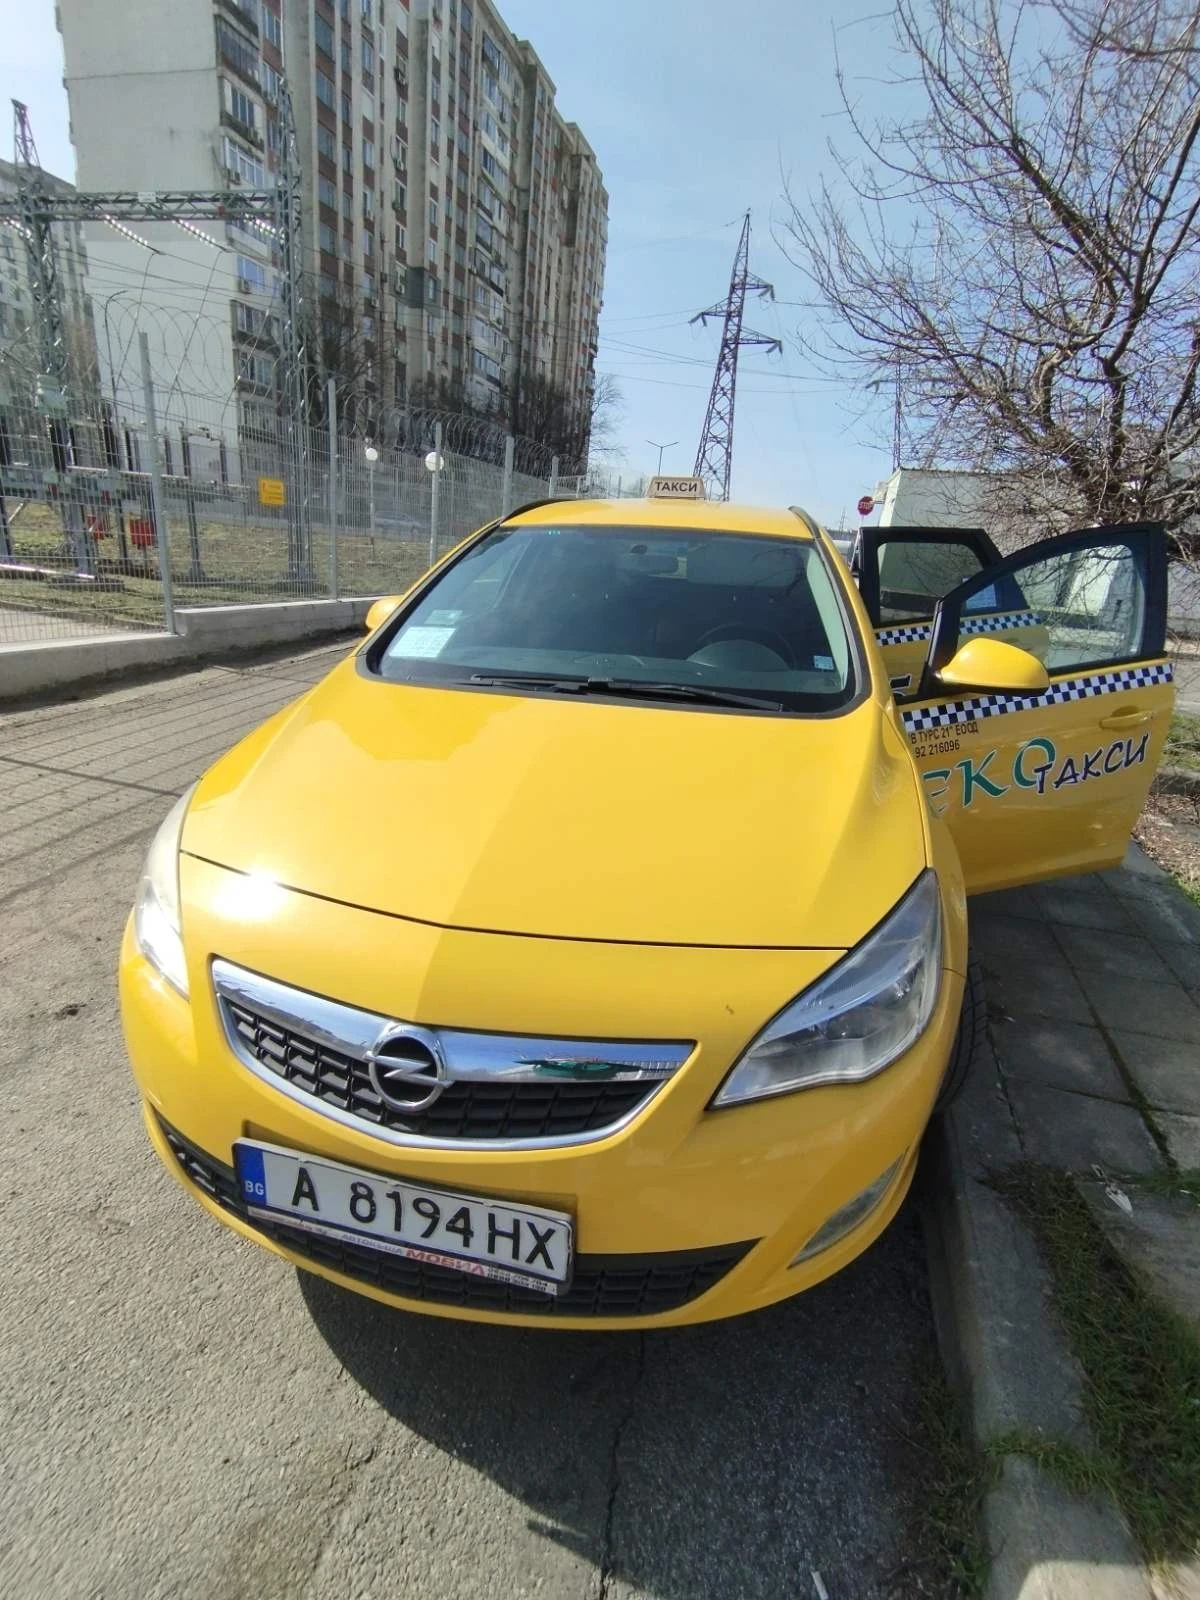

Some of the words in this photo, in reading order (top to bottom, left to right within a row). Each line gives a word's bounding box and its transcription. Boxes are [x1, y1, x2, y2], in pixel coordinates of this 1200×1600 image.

[655, 481, 698, 492] ТАКСИ
[918, 729, 940, 742] ТУРС
[955, 721, 979, 736] ЕООД
[928, 739, 960, 756] 216096
[1033, 732, 1149, 794] ТАКСИ
[245, 1181, 265, 1196] BG
